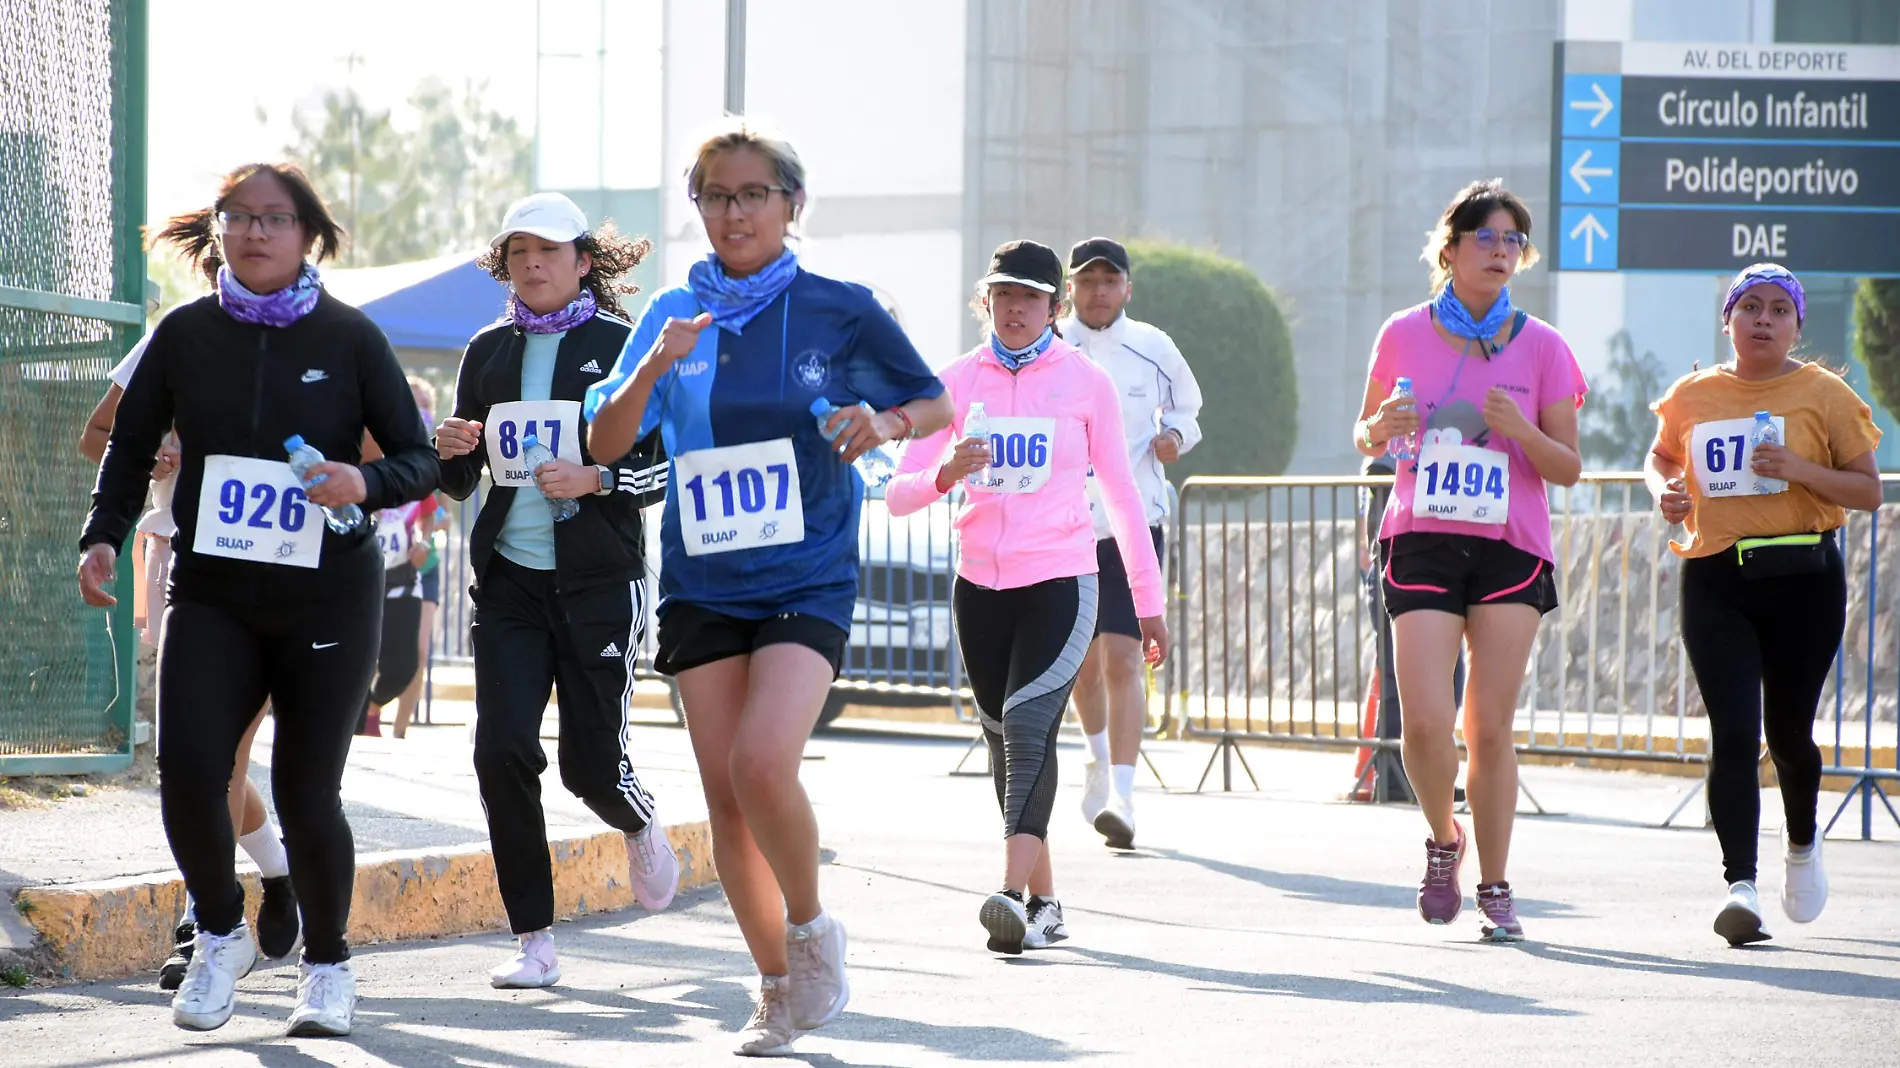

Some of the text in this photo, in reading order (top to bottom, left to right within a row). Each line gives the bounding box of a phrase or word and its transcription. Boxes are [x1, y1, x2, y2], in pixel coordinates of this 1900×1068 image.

[1684, 49, 1848, 72] AV. DEL DEPORTE
[1658, 88, 1869, 129] Círculo Infantil
[1665, 156, 1859, 202] Polideportivo
[1732, 223, 1788, 258] DAE
[990, 432, 1048, 469] 006
[505, 469, 530, 480] BUAP
[1423, 460, 1505, 500] 1494
[1708, 481, 1737, 492] BUAP
[217, 478, 308, 534] 926
[685, 462, 790, 523] 1107
[1427, 503, 1458, 515] BUAP
[215, 536, 255, 552] BUAP
[700, 529, 738, 545] BUAP
